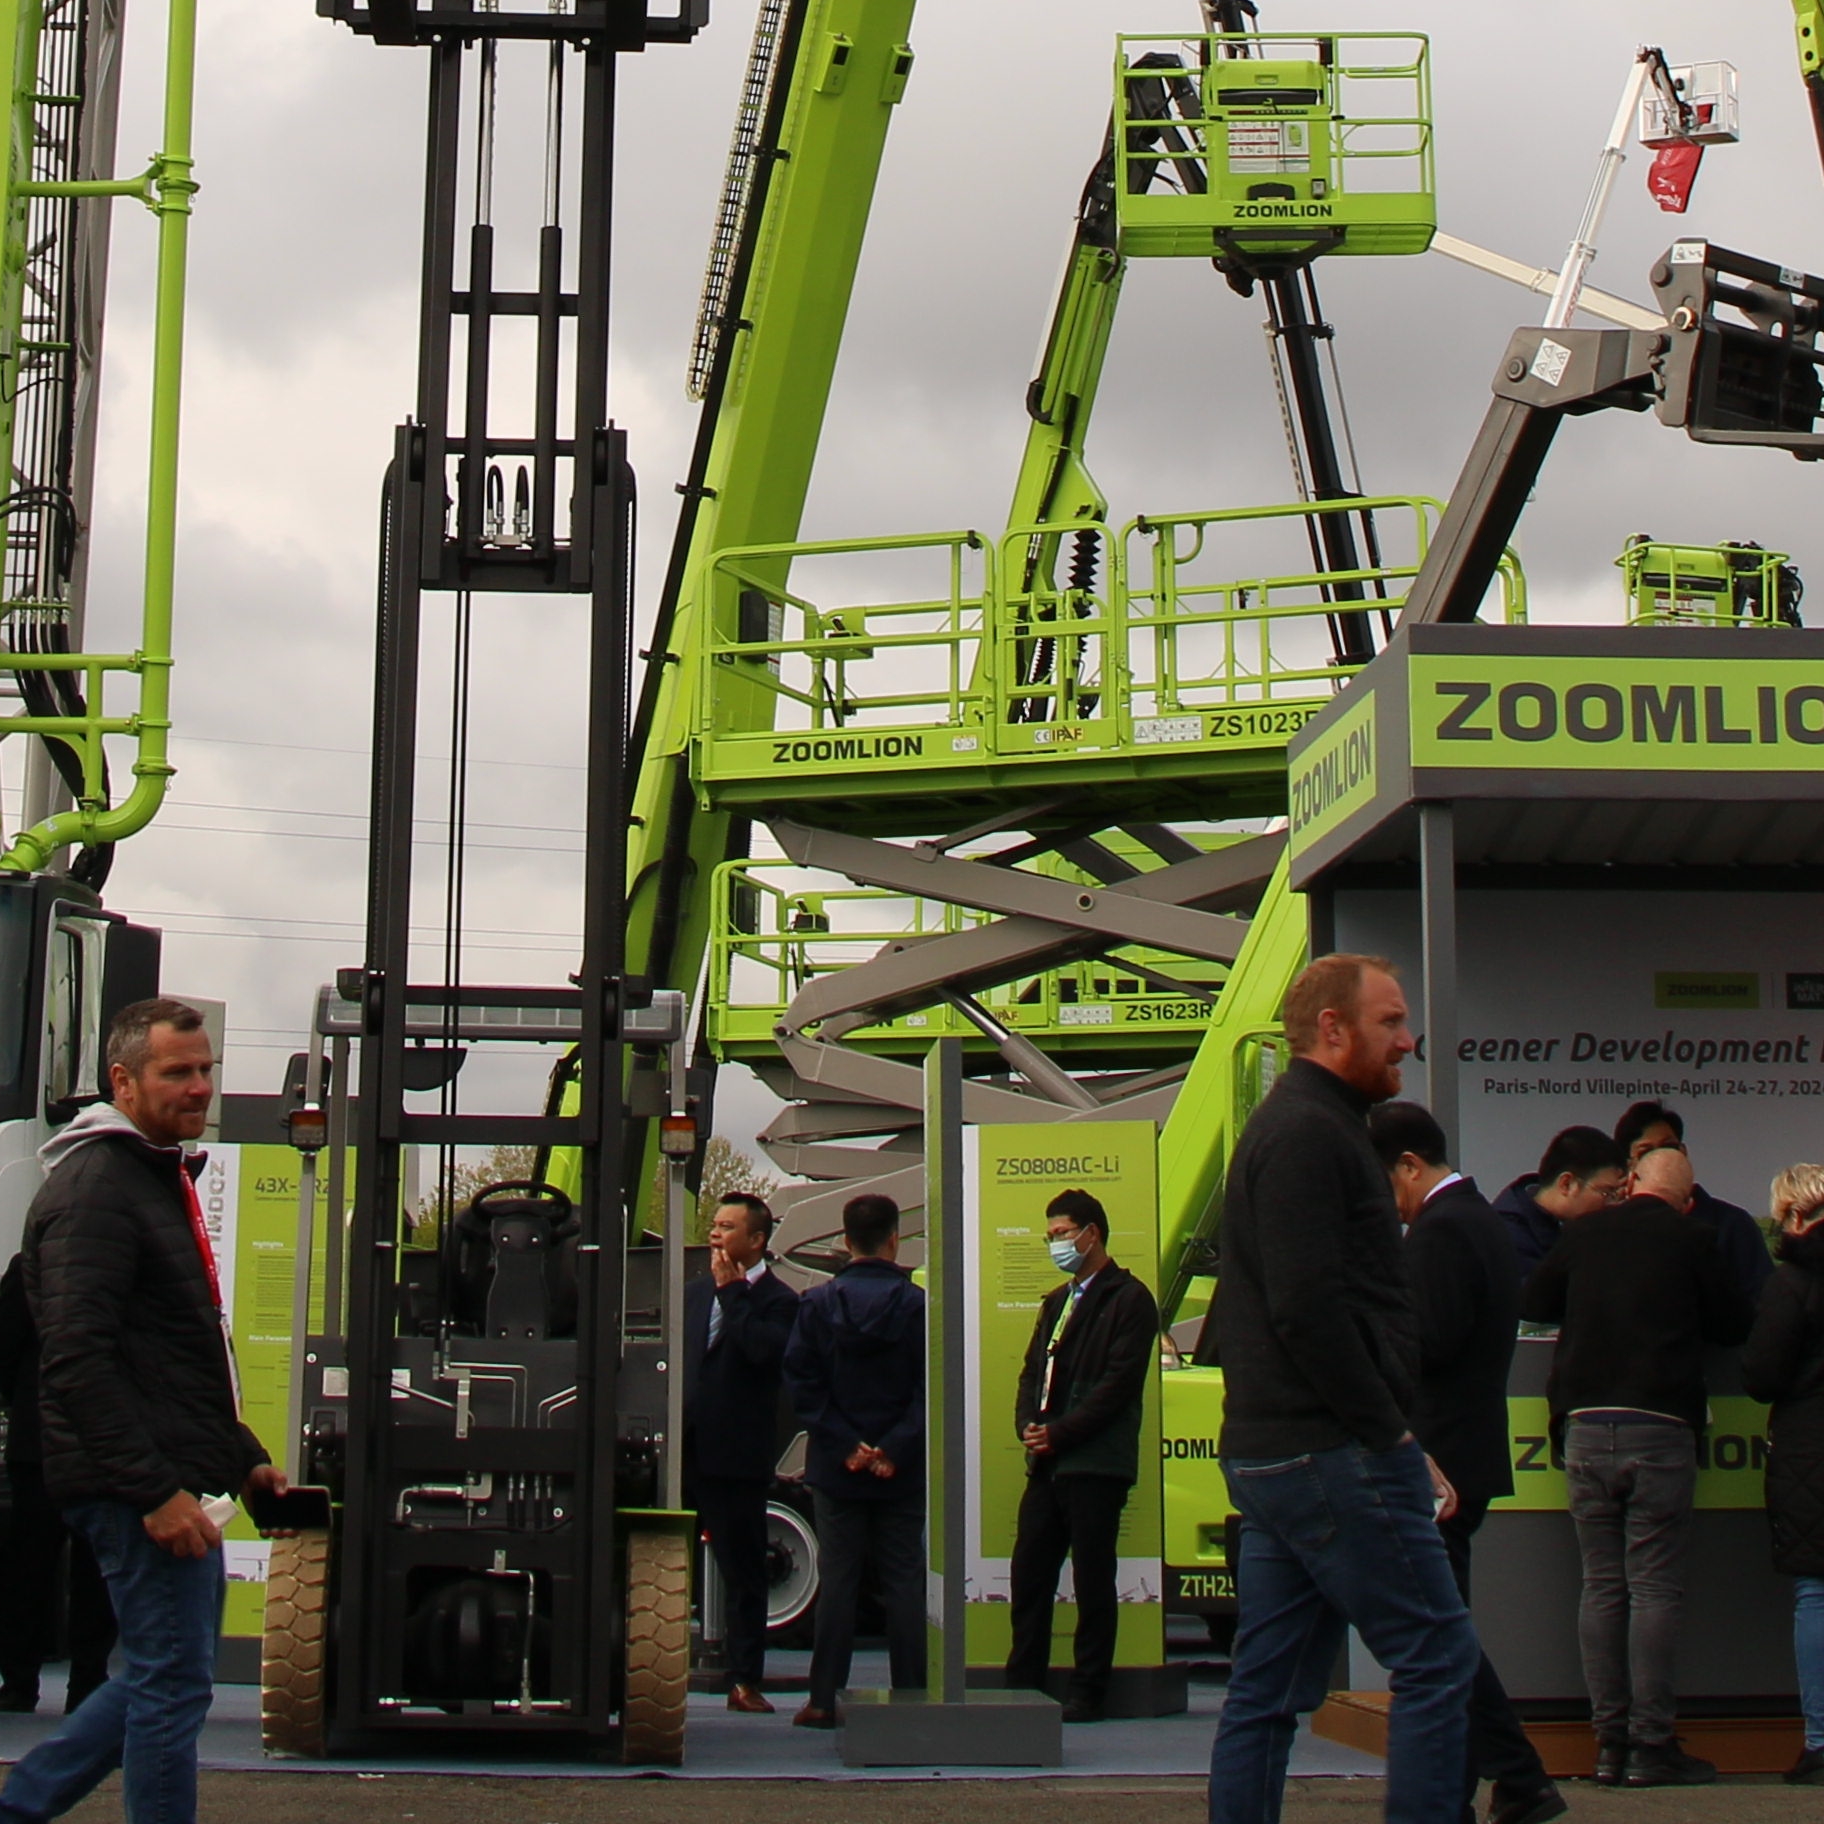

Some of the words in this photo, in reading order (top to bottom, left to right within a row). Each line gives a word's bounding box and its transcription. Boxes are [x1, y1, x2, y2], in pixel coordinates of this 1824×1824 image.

[1233, 205, 1333, 218] ZOOMLION
[773, 735, 923, 763] ZOOMLION
[1291, 719, 1373, 835] ZOOMLION
[1667, 983, 1748, 997] ZOOMLION
[1414, 1033, 1560, 1063] eener
[1570, 1031, 1810, 1070] Development
[1484, 1078, 1581, 1095] Paris-Nord
[1587, 1078, 1721, 1097] Villepinte-April
[1727, 1079, 1784, 1097] 24-27,
[996, 1155, 1120, 1176] ZS0808AC-Li
